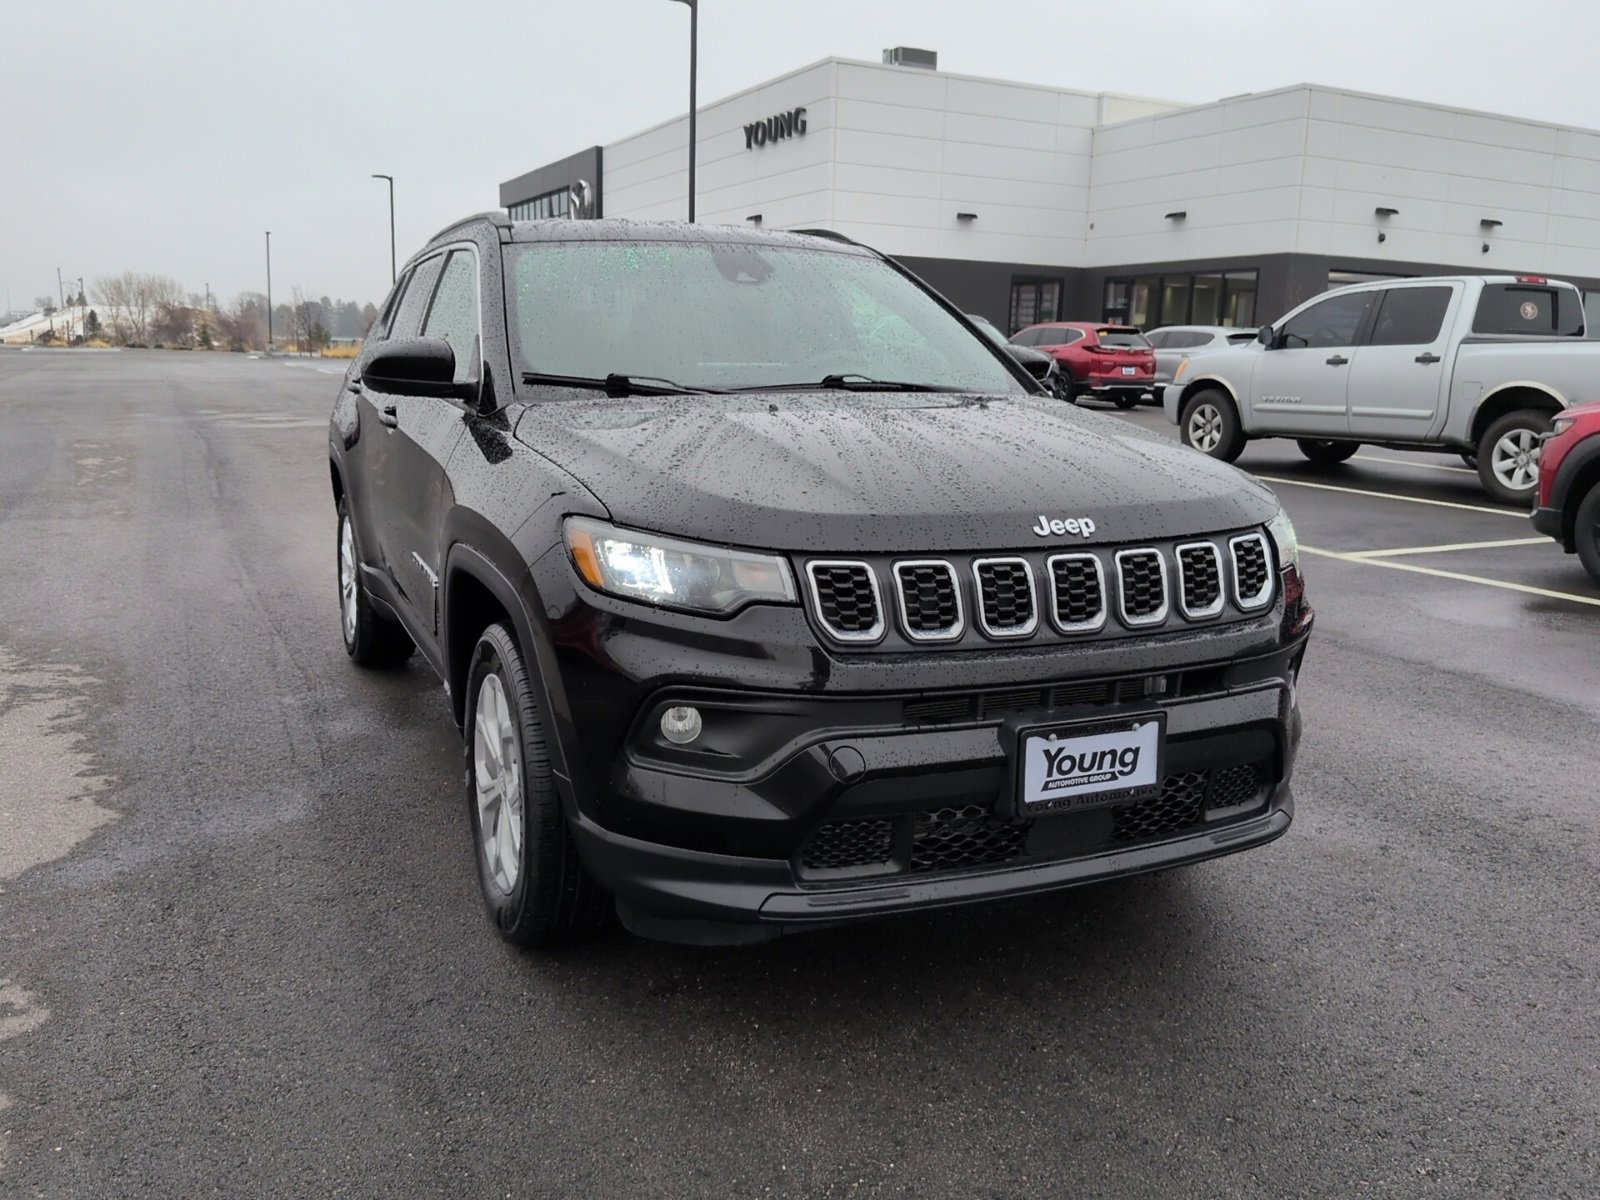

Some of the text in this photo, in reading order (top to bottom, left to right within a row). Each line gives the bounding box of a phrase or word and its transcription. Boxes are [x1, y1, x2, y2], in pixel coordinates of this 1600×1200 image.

[743, 106, 807, 150] YOUNG
[1033, 515, 1096, 538] Jeep
[1042, 746, 1141, 778] Young
[1048, 773, 1112, 789] AUTOMOTIVE GROUP
